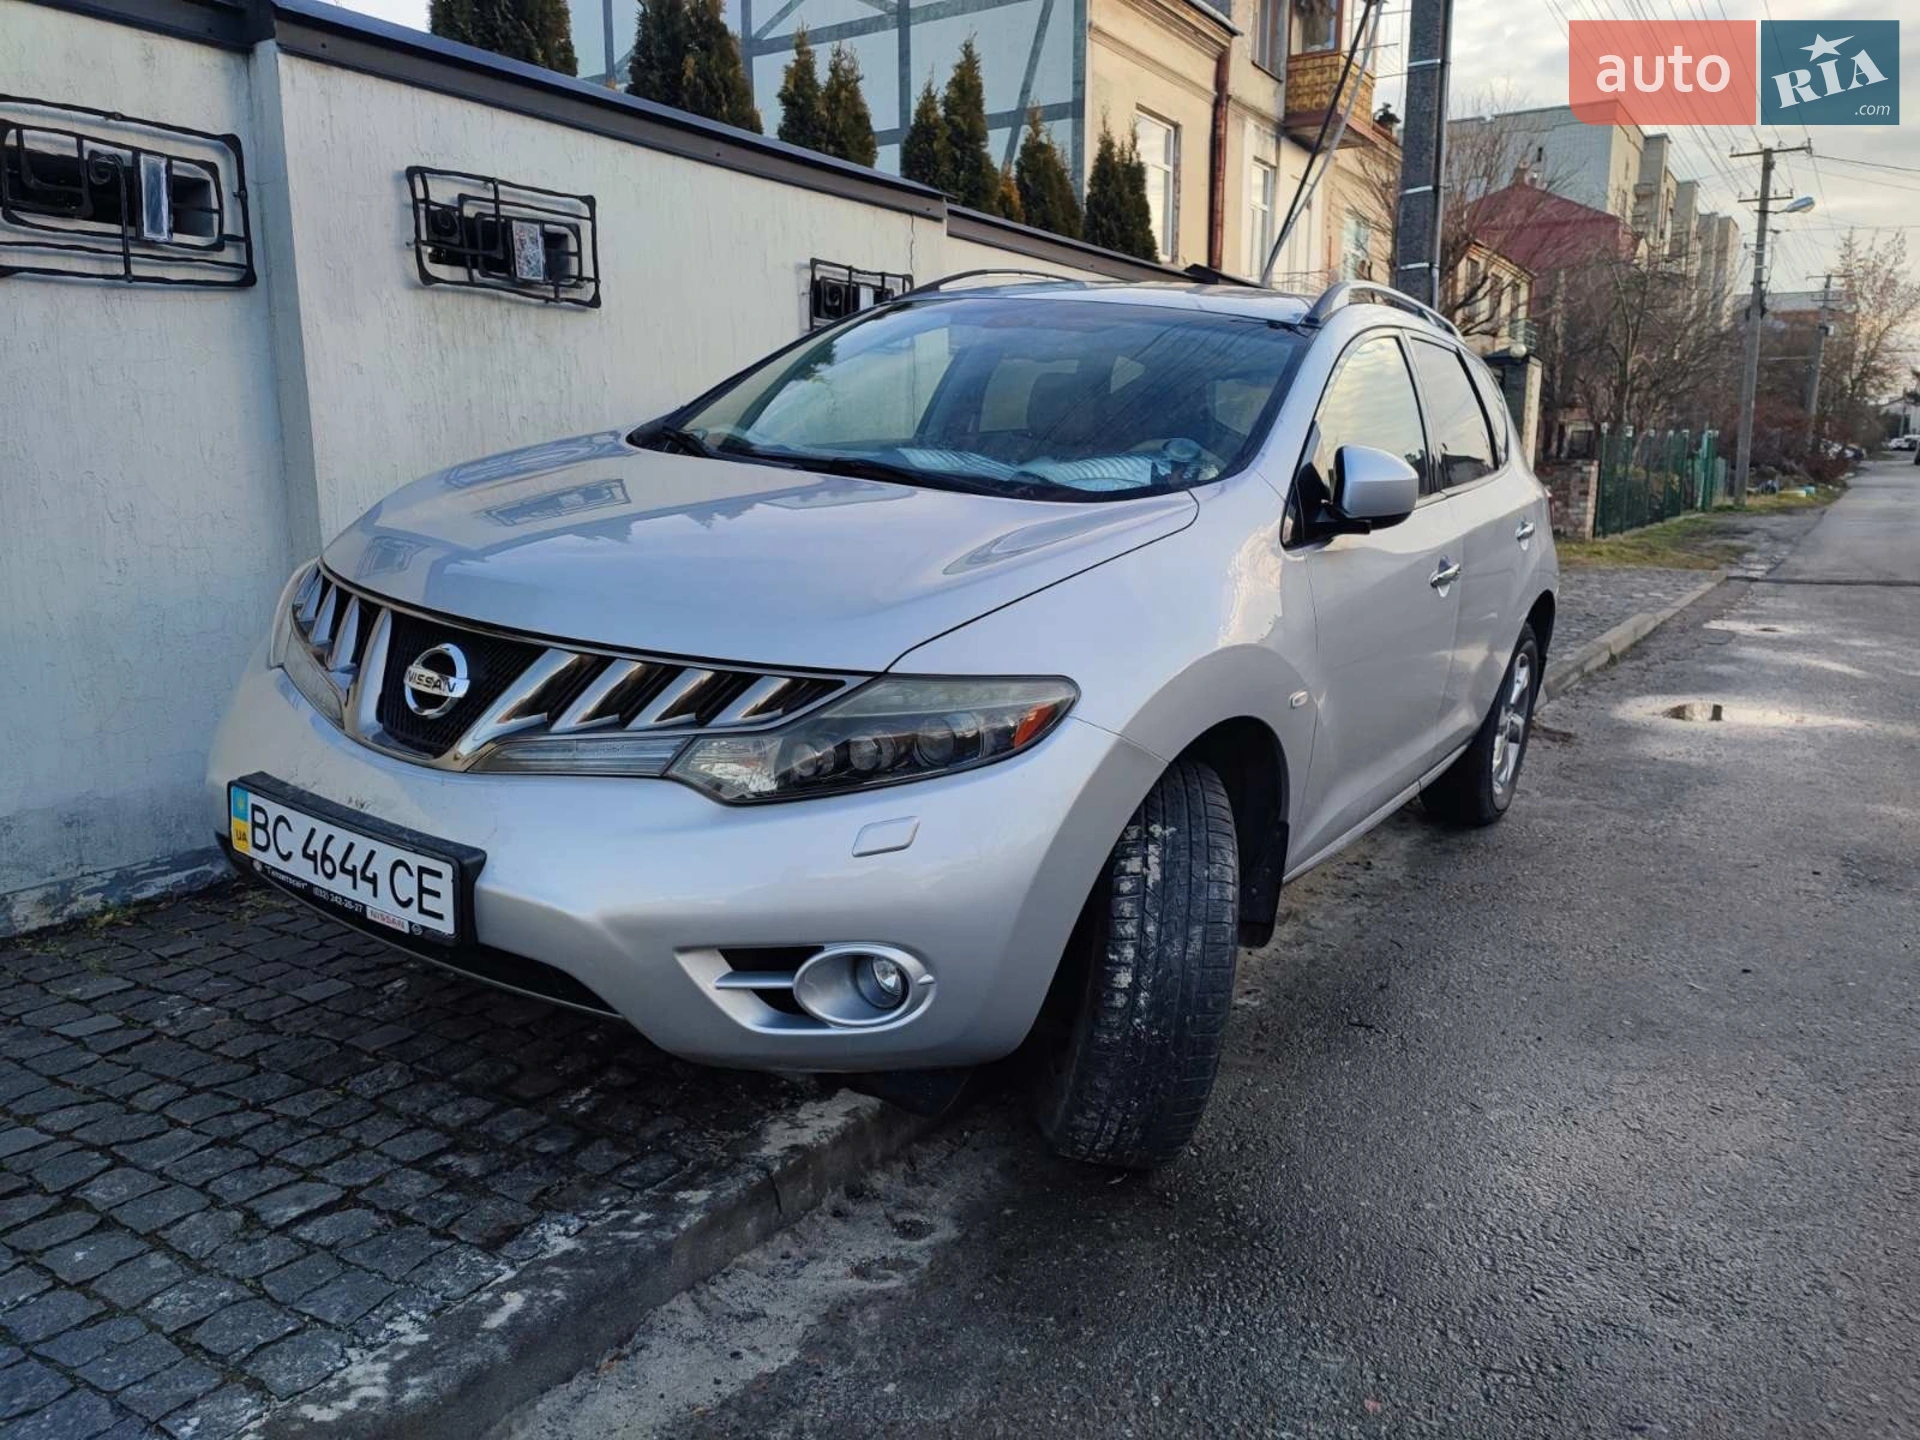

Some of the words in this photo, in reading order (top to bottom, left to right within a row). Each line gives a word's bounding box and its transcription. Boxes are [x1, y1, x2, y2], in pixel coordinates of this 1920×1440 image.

[407, 669, 457, 693] NISSAN
[235, 829, 248, 842] UA
[251, 803, 293, 862] BC
[302, 827, 378, 898] 4644
[389, 858, 445, 920] CE
